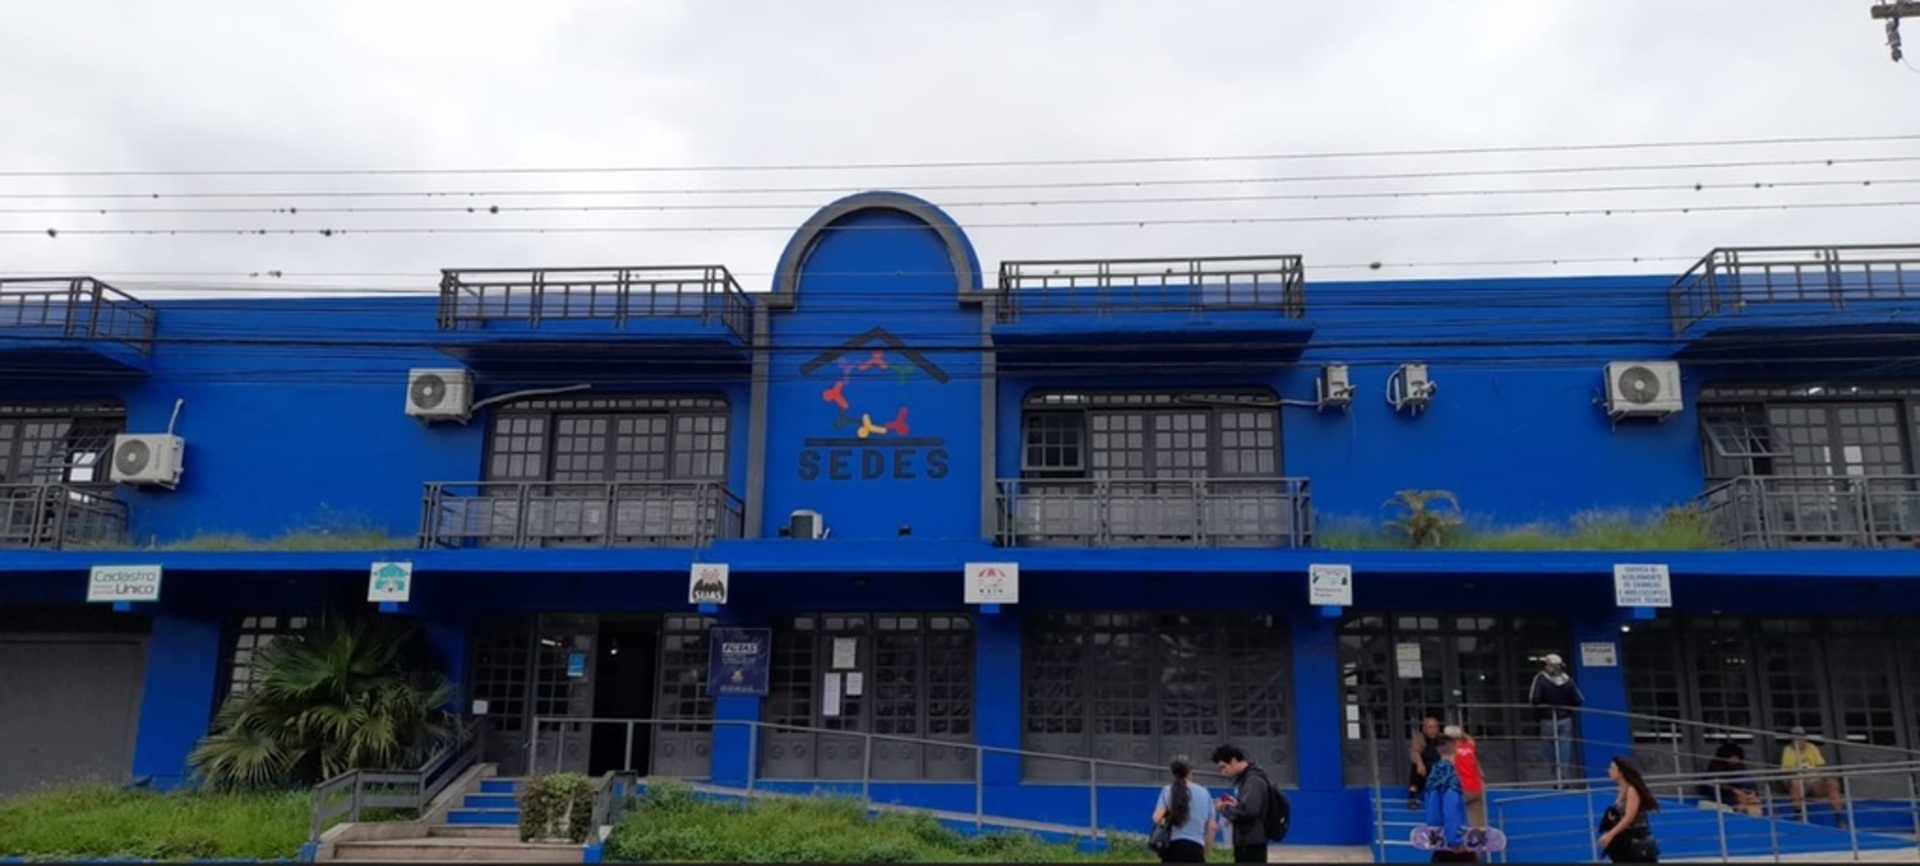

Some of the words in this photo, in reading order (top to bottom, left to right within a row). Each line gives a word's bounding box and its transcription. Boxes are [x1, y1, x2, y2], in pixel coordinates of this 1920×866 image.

[798, 449, 949, 481] SEDES
[94, 571, 155, 581] Cadastro
[695, 591, 722, 599] SUAS
